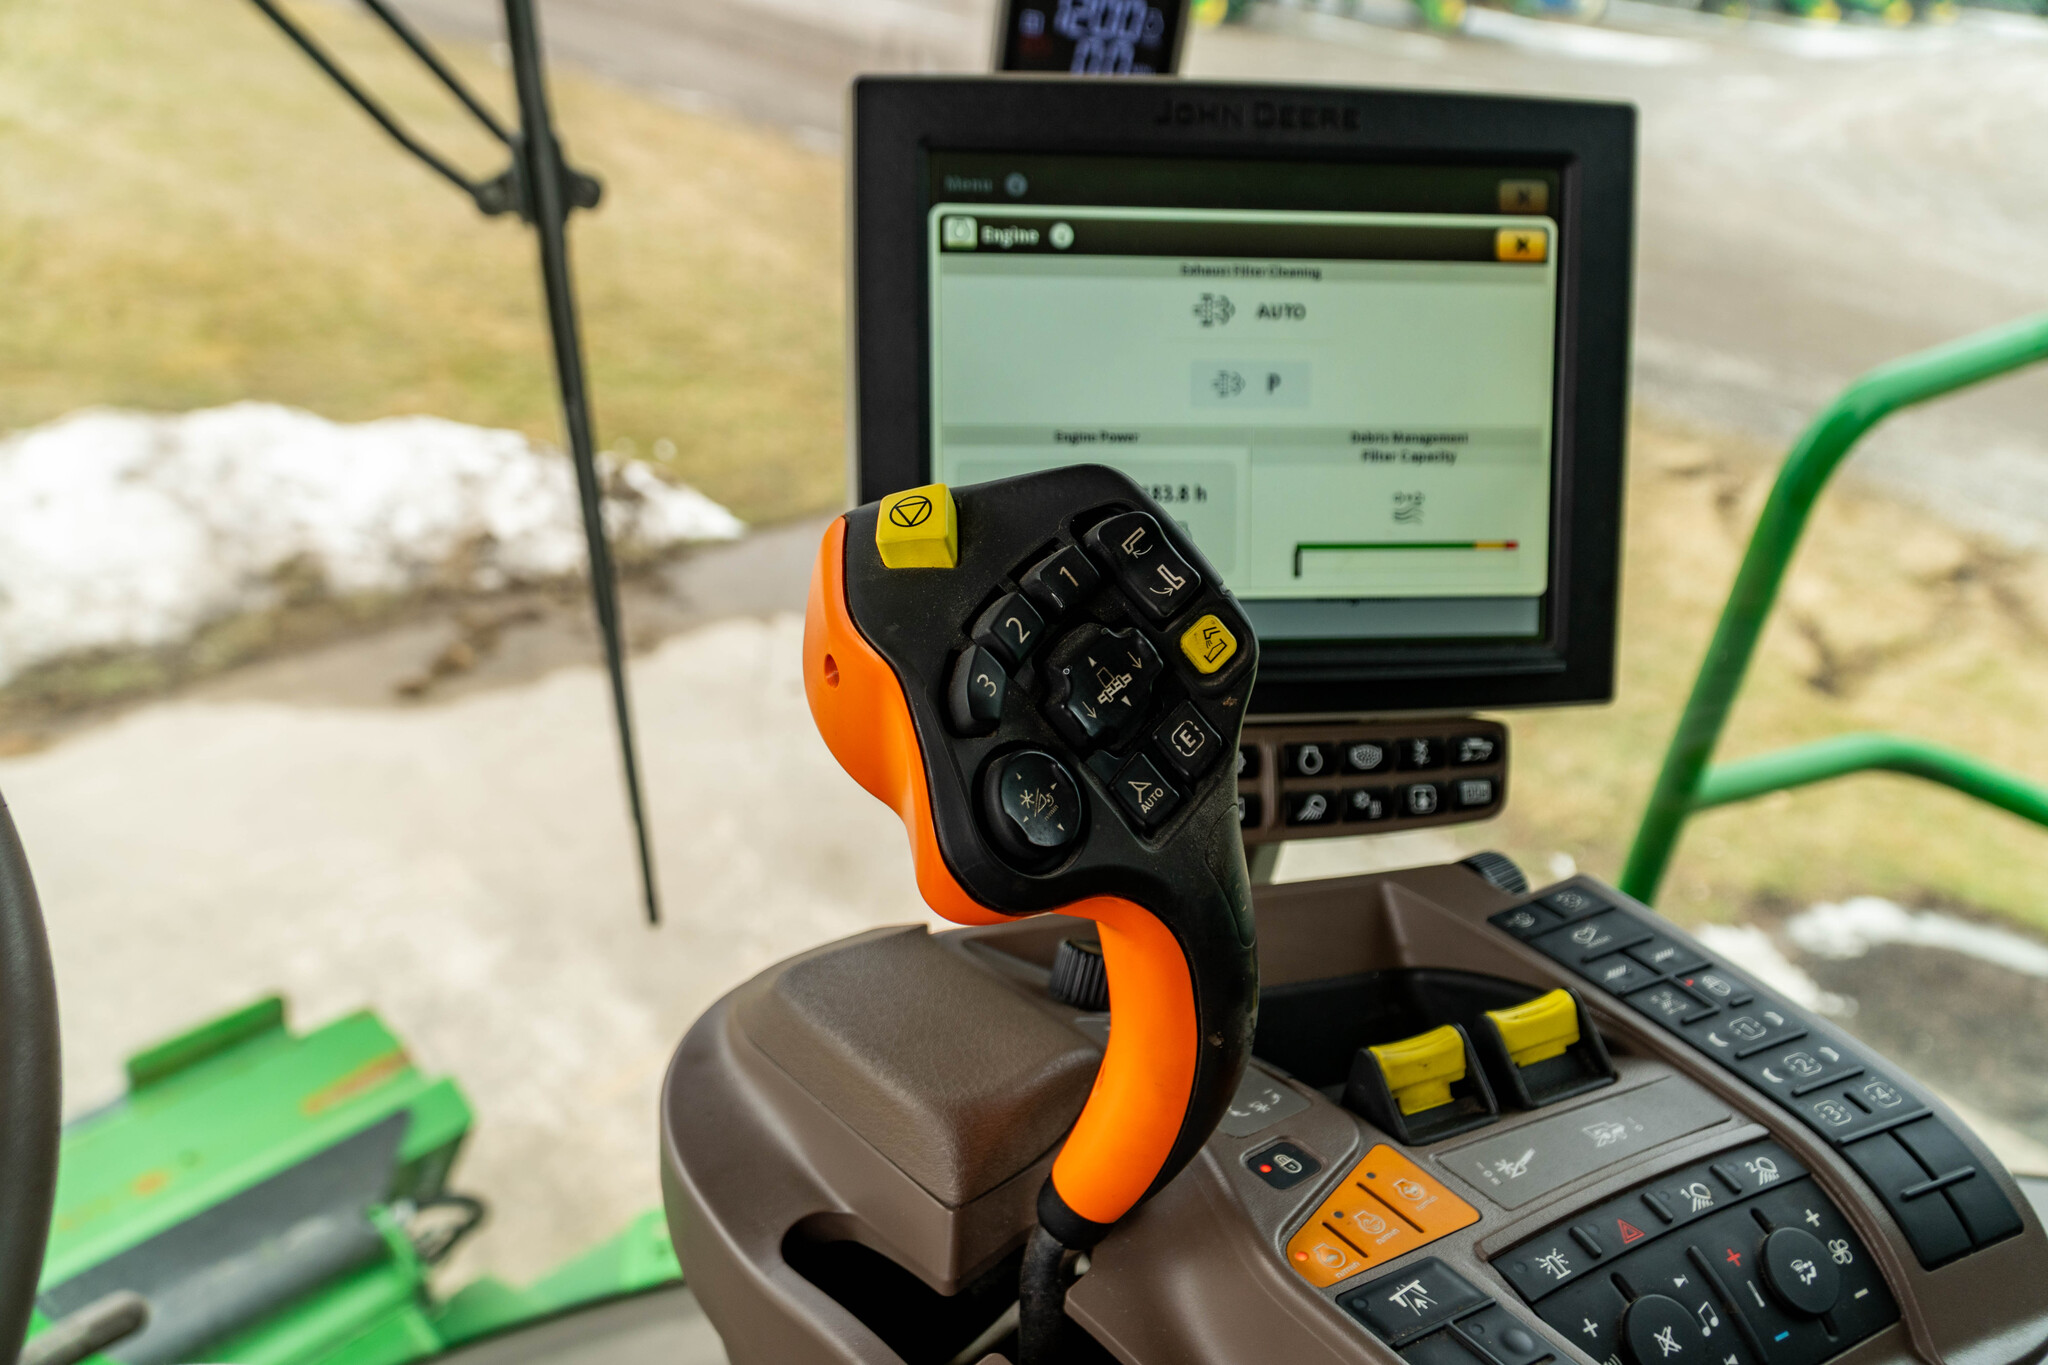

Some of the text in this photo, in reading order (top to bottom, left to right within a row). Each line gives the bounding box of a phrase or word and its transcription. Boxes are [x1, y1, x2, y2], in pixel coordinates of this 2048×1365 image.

[1155, 98, 1361, 131] JOHN DEERE
[945, 175, 993, 192] Menu
[981, 225, 1040, 249] Engine
[1180, 264, 1323, 281] Exhaust Filter Cleaning
[1257, 302, 1307, 321] AUTO
[1266, 371, 1282, 395] P
[1054, 429, 1140, 446] Engine Power
[1351, 430, 1470, 447] Debris Management
[1361, 450, 1458, 467] Filter Capacity
[1059, 565, 1080, 588] 1
[1004, 616, 1032, 645] 2
[976, 673, 998, 698] 3
[1179, 728, 1197, 749] E
[1140, 787, 1165, 815] AUTO
[1793, 1057, 1814, 1073] 2
[1822, 1104, 1842, 1122] 3
[1744, 1160, 1758, 1174] 2
[1680, 1187, 1692, 1200] 1
